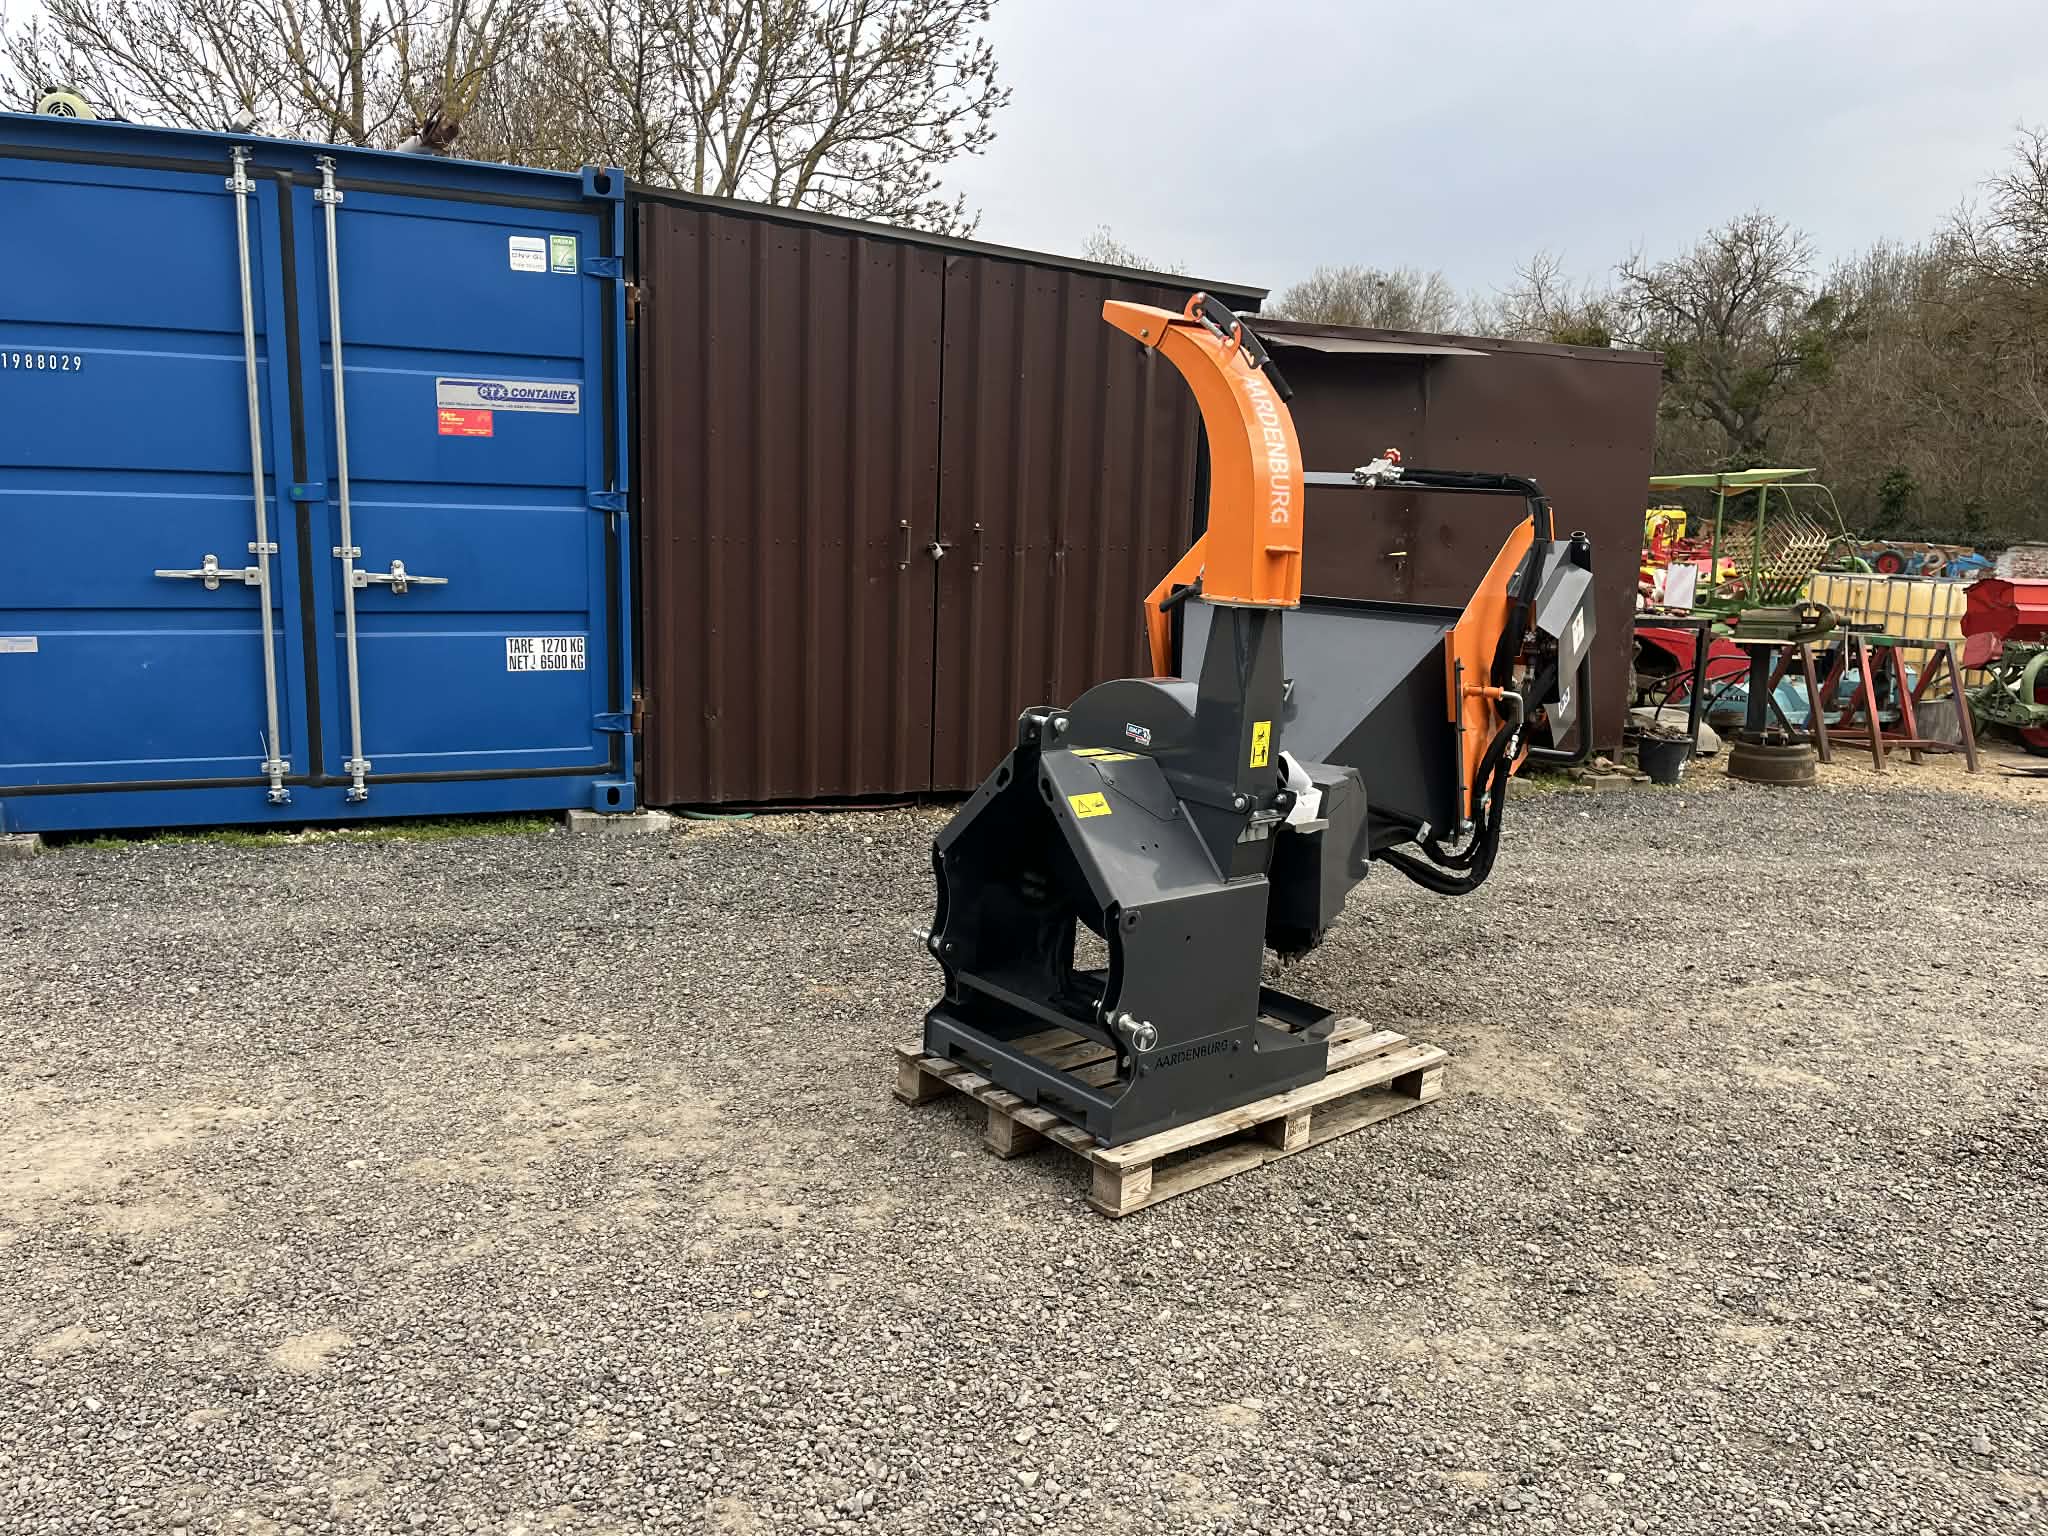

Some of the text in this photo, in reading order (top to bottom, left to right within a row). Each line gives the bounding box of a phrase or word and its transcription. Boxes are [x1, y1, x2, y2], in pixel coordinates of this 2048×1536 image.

[0, 352, 81, 371] 1988029
[511, 387, 577, 400] CONTAINEX
[1245, 375, 1291, 524] AARDENBURG
[508, 637, 583, 654] TARE 1270 KG
[540, 654, 568, 669] 6500
[570, 654, 584, 669] KG
[1154, 1039, 1228, 1072] AARDENBURG
